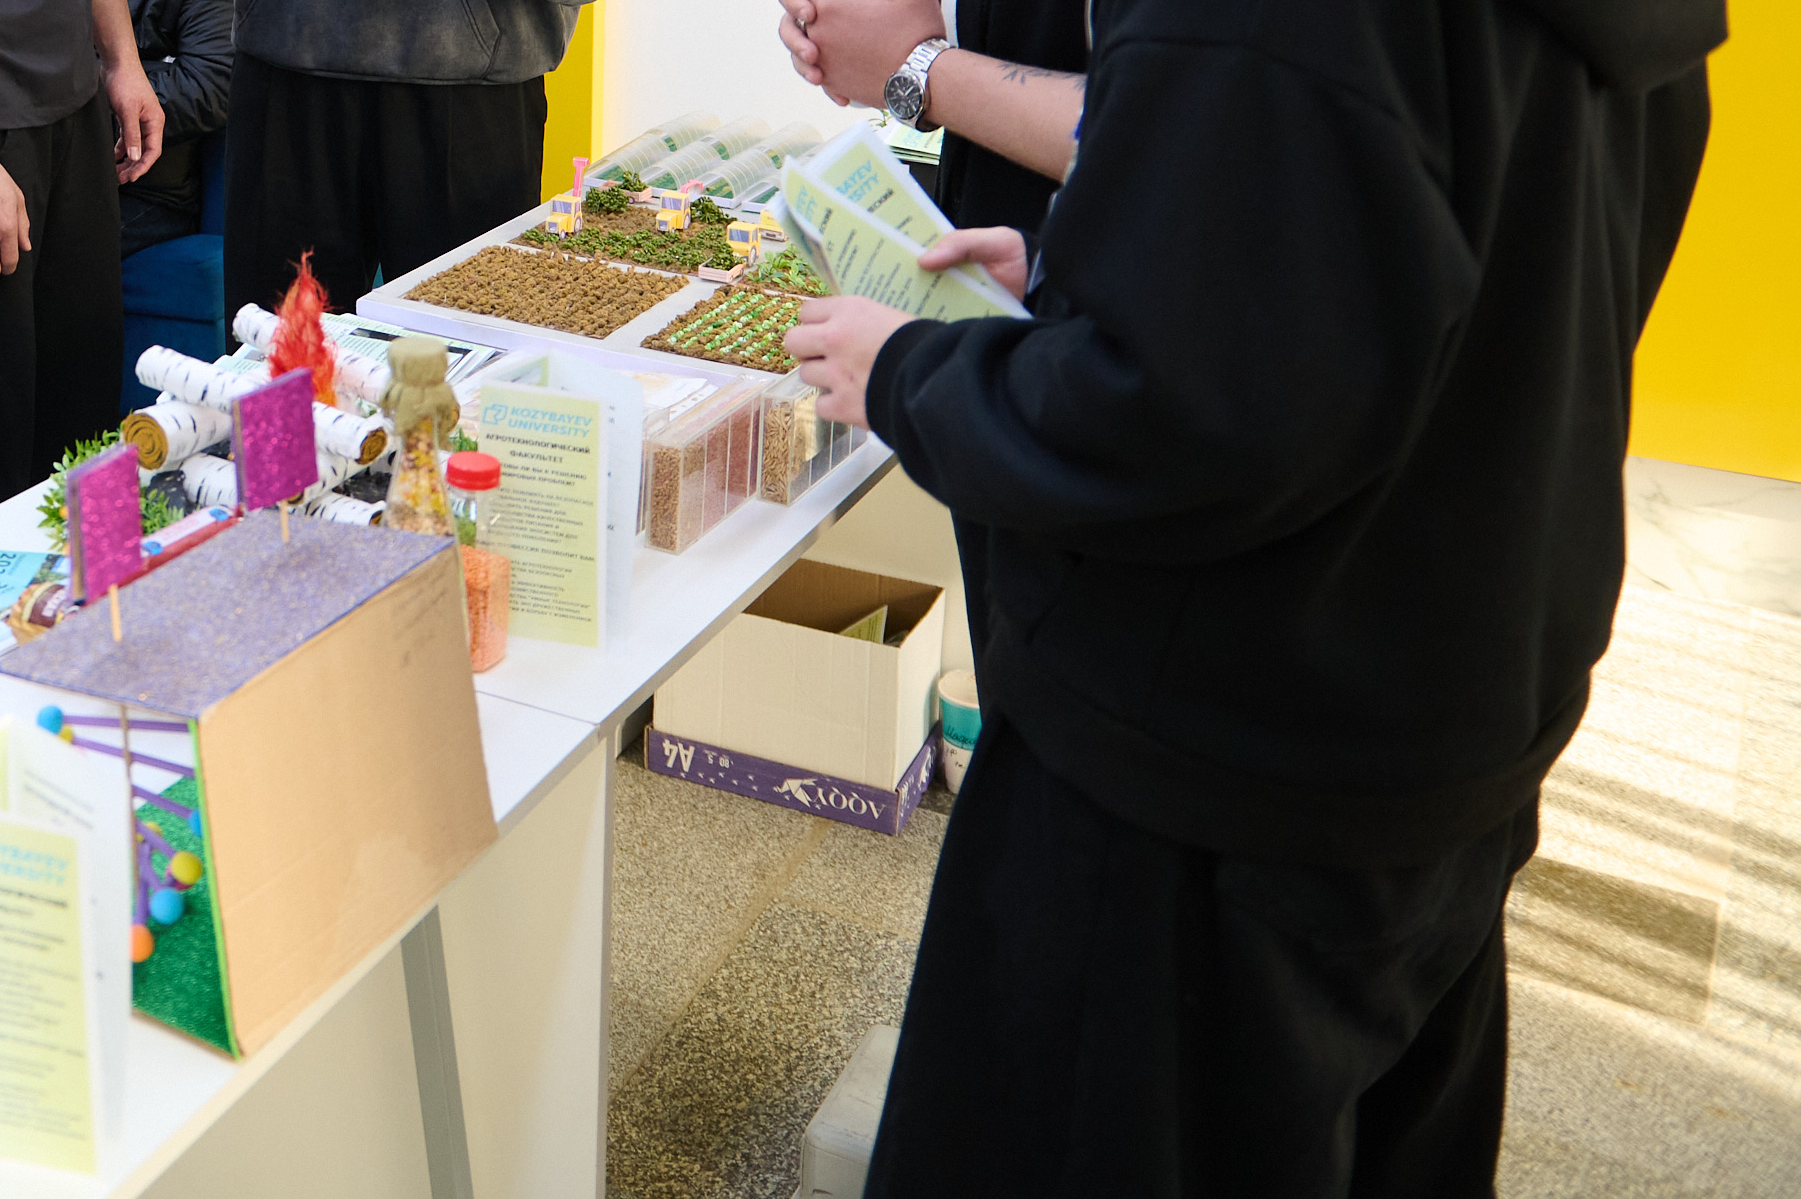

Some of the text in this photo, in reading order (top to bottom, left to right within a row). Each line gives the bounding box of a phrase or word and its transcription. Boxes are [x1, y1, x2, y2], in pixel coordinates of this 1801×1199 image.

[511, 406, 593, 427] KOZYBAYEV
[508, 418, 590, 439] UNIVERSITY
[485, 432, 591, 454] АГРОТЕХНОЛОГИЧЕСКИЙ
[509, 449, 564, 464] ФАКУЛЬТЕТ
[662, 738, 695, 773] A4
[707, 754, 714, 764] 5
[814, 786, 887, 821] AQQY
